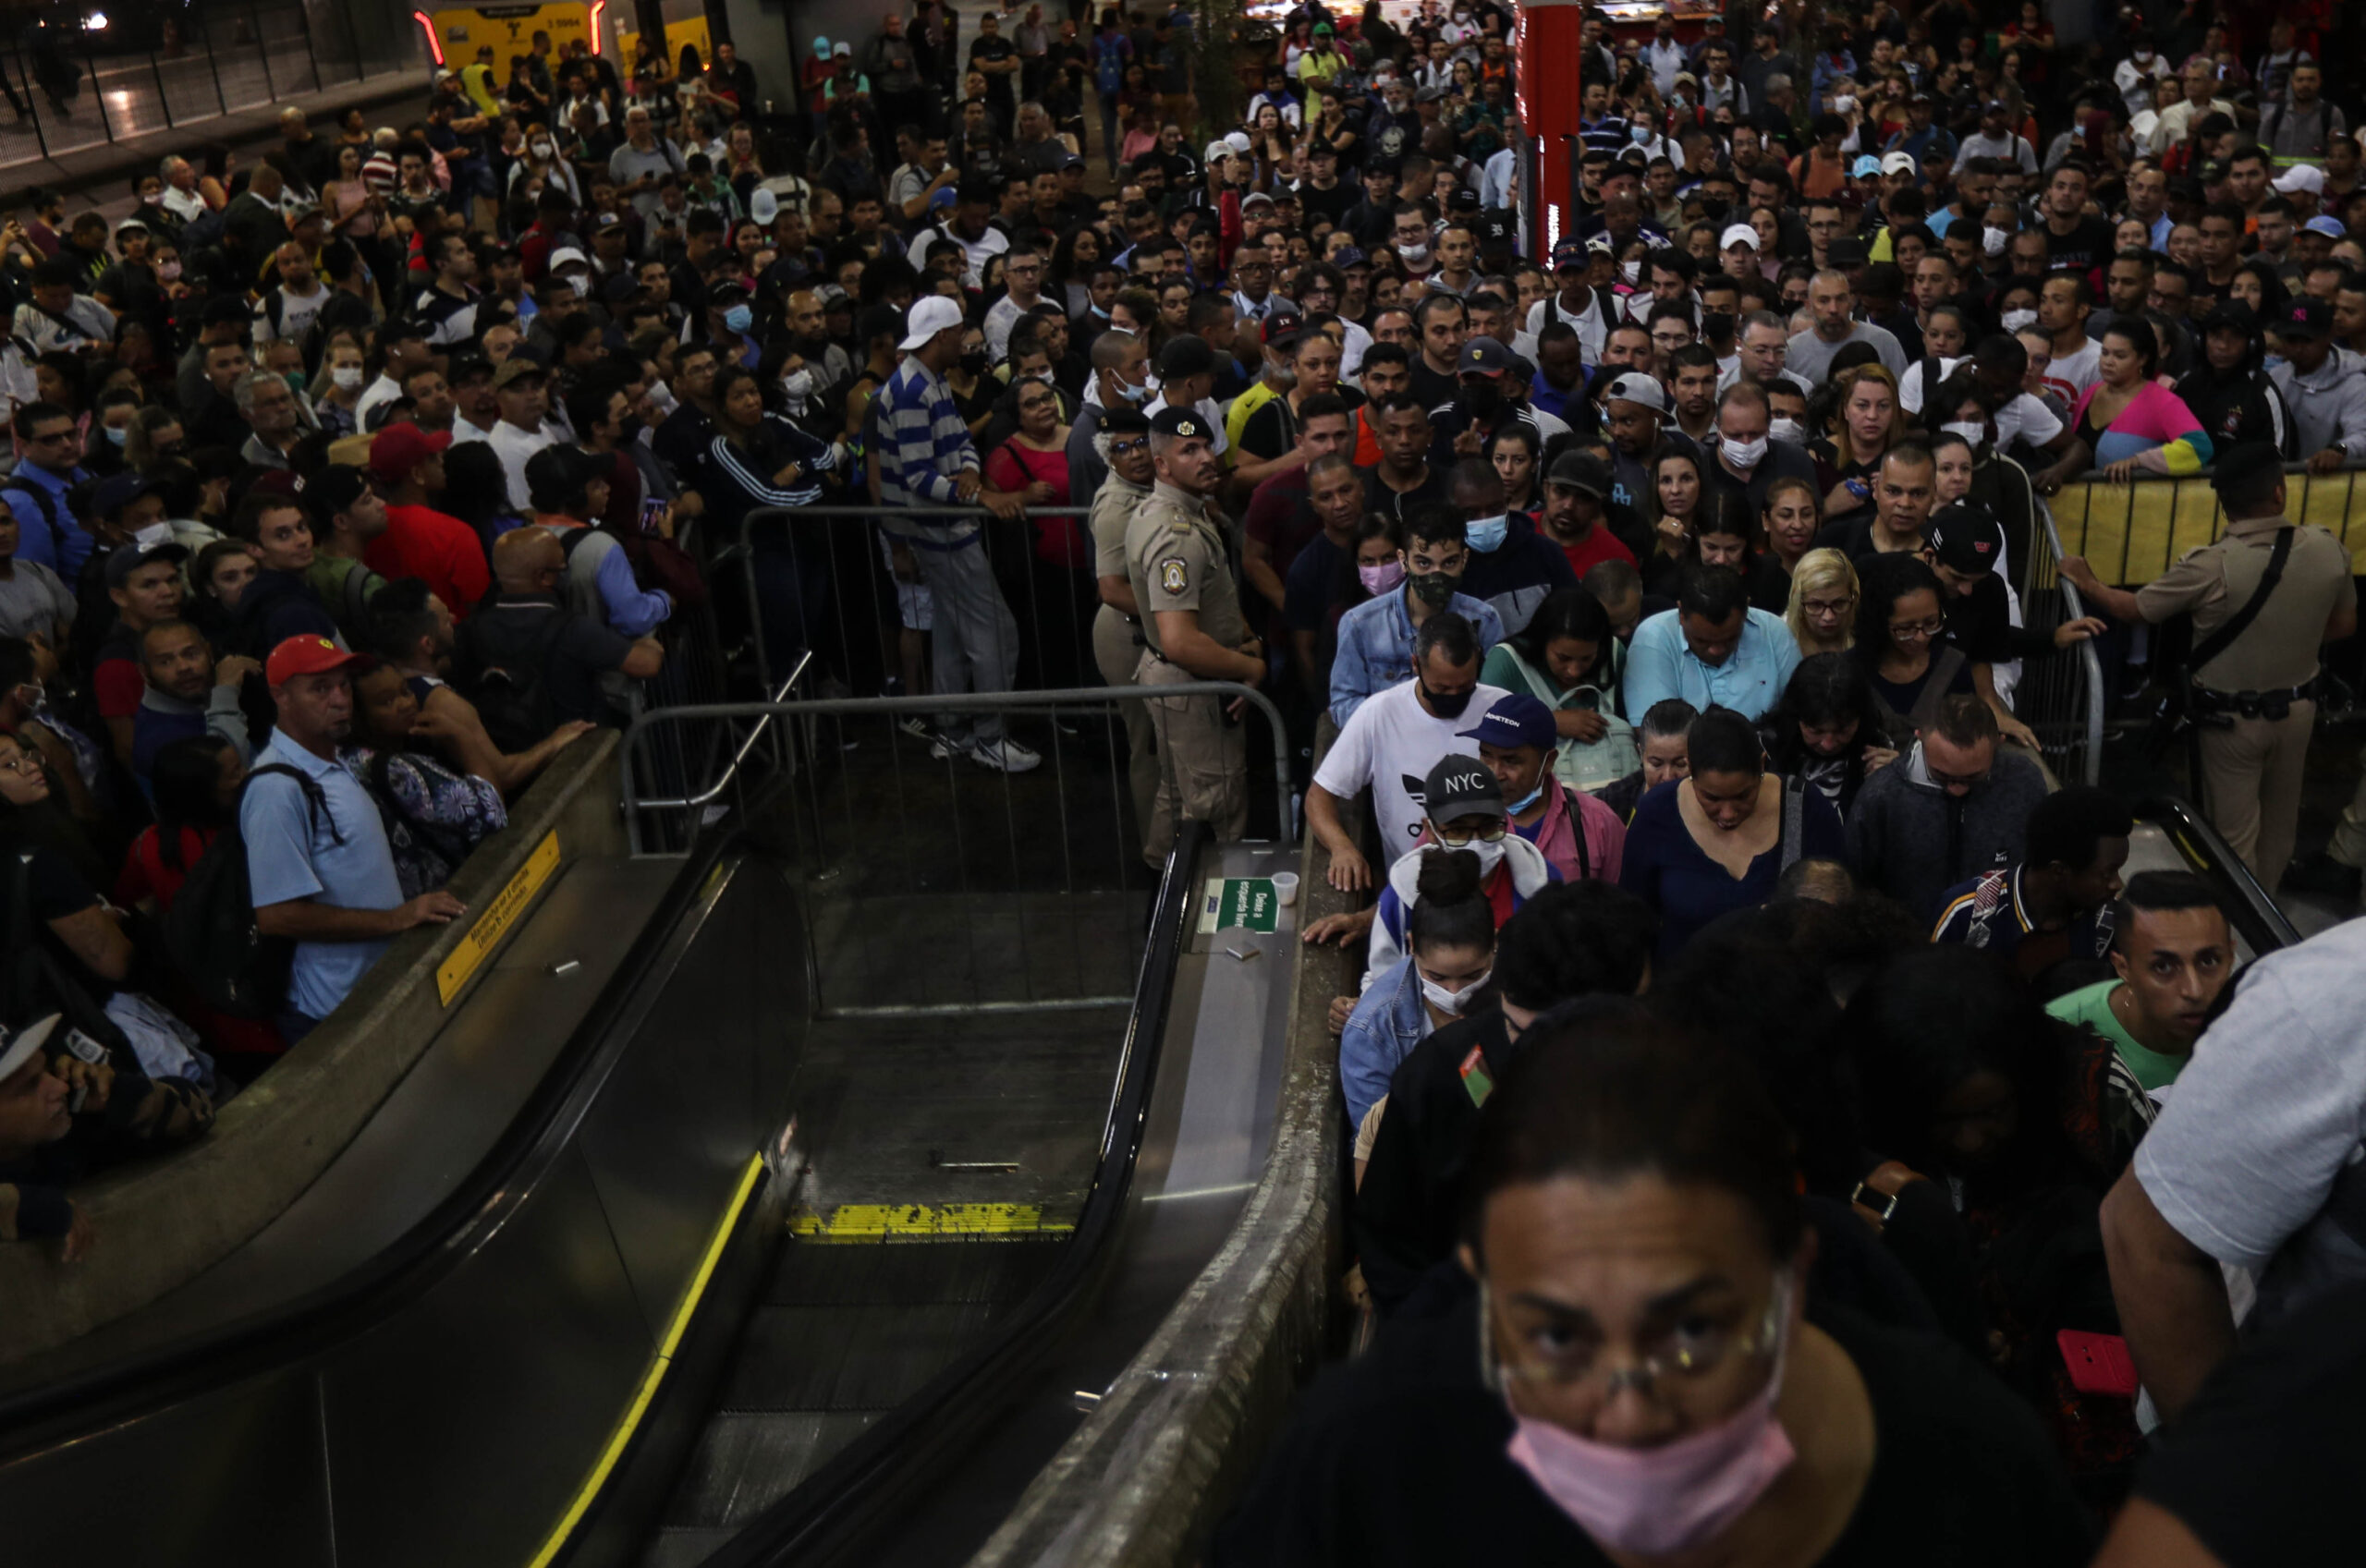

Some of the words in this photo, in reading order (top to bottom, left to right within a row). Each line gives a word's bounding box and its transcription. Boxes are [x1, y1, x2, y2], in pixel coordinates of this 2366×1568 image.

[1445, 772, 1485, 795] NYC
[1237, 881, 1250, 913] esquerda
[1253, 893, 1268, 913] Deixe
[1235, 913, 1249, 928] livre
